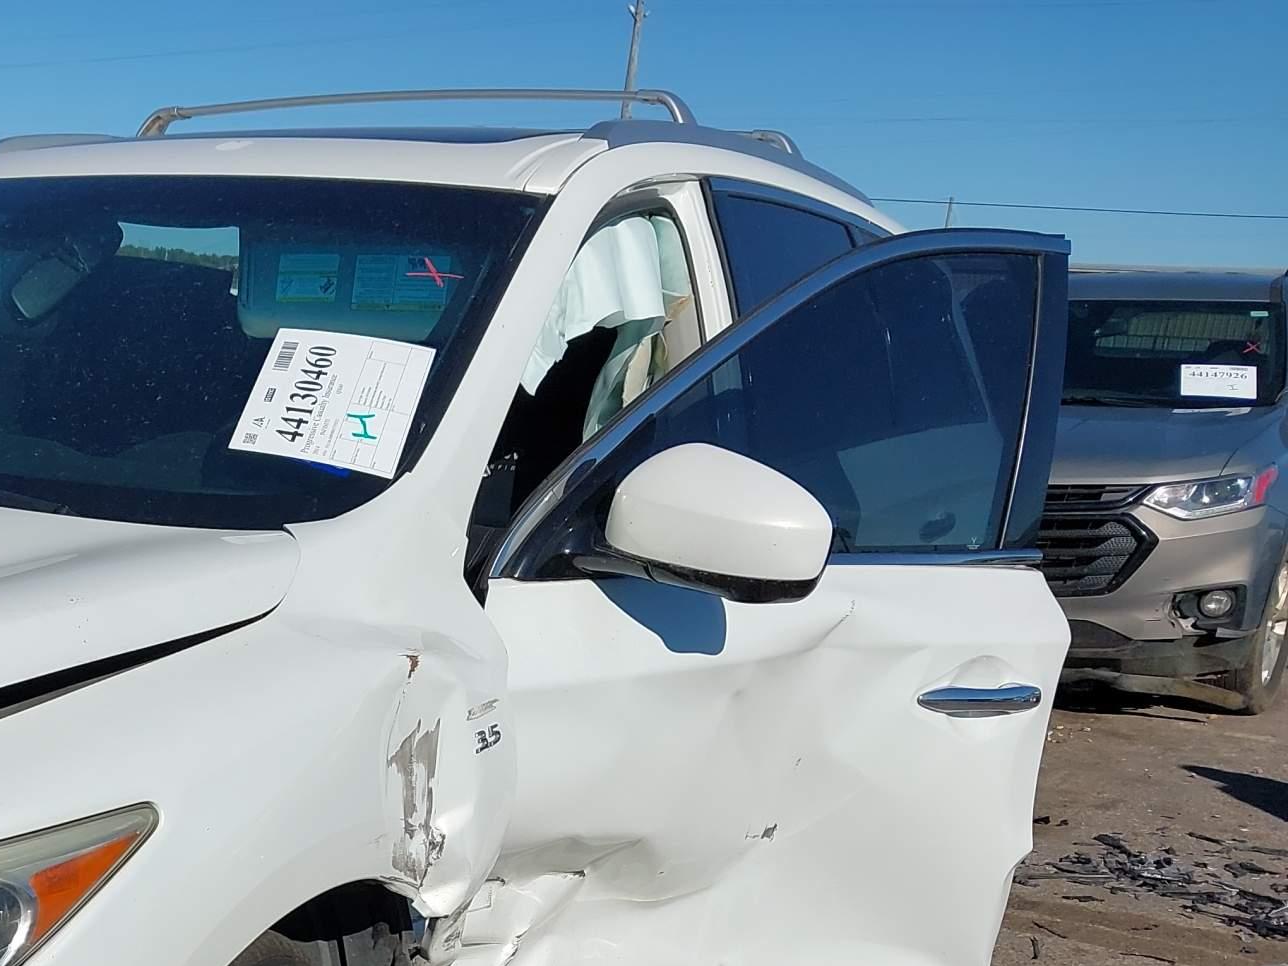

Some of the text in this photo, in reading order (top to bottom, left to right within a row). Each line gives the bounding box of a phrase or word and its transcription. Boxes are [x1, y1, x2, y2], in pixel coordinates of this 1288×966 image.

[275, 345, 337, 443] 44130460
[300, 421, 319, 454] Progressive
[312, 399, 328, 422] Casualty
[321, 373, 338, 398] Insurance
[1189, 371, 1248, 380] 44147926
